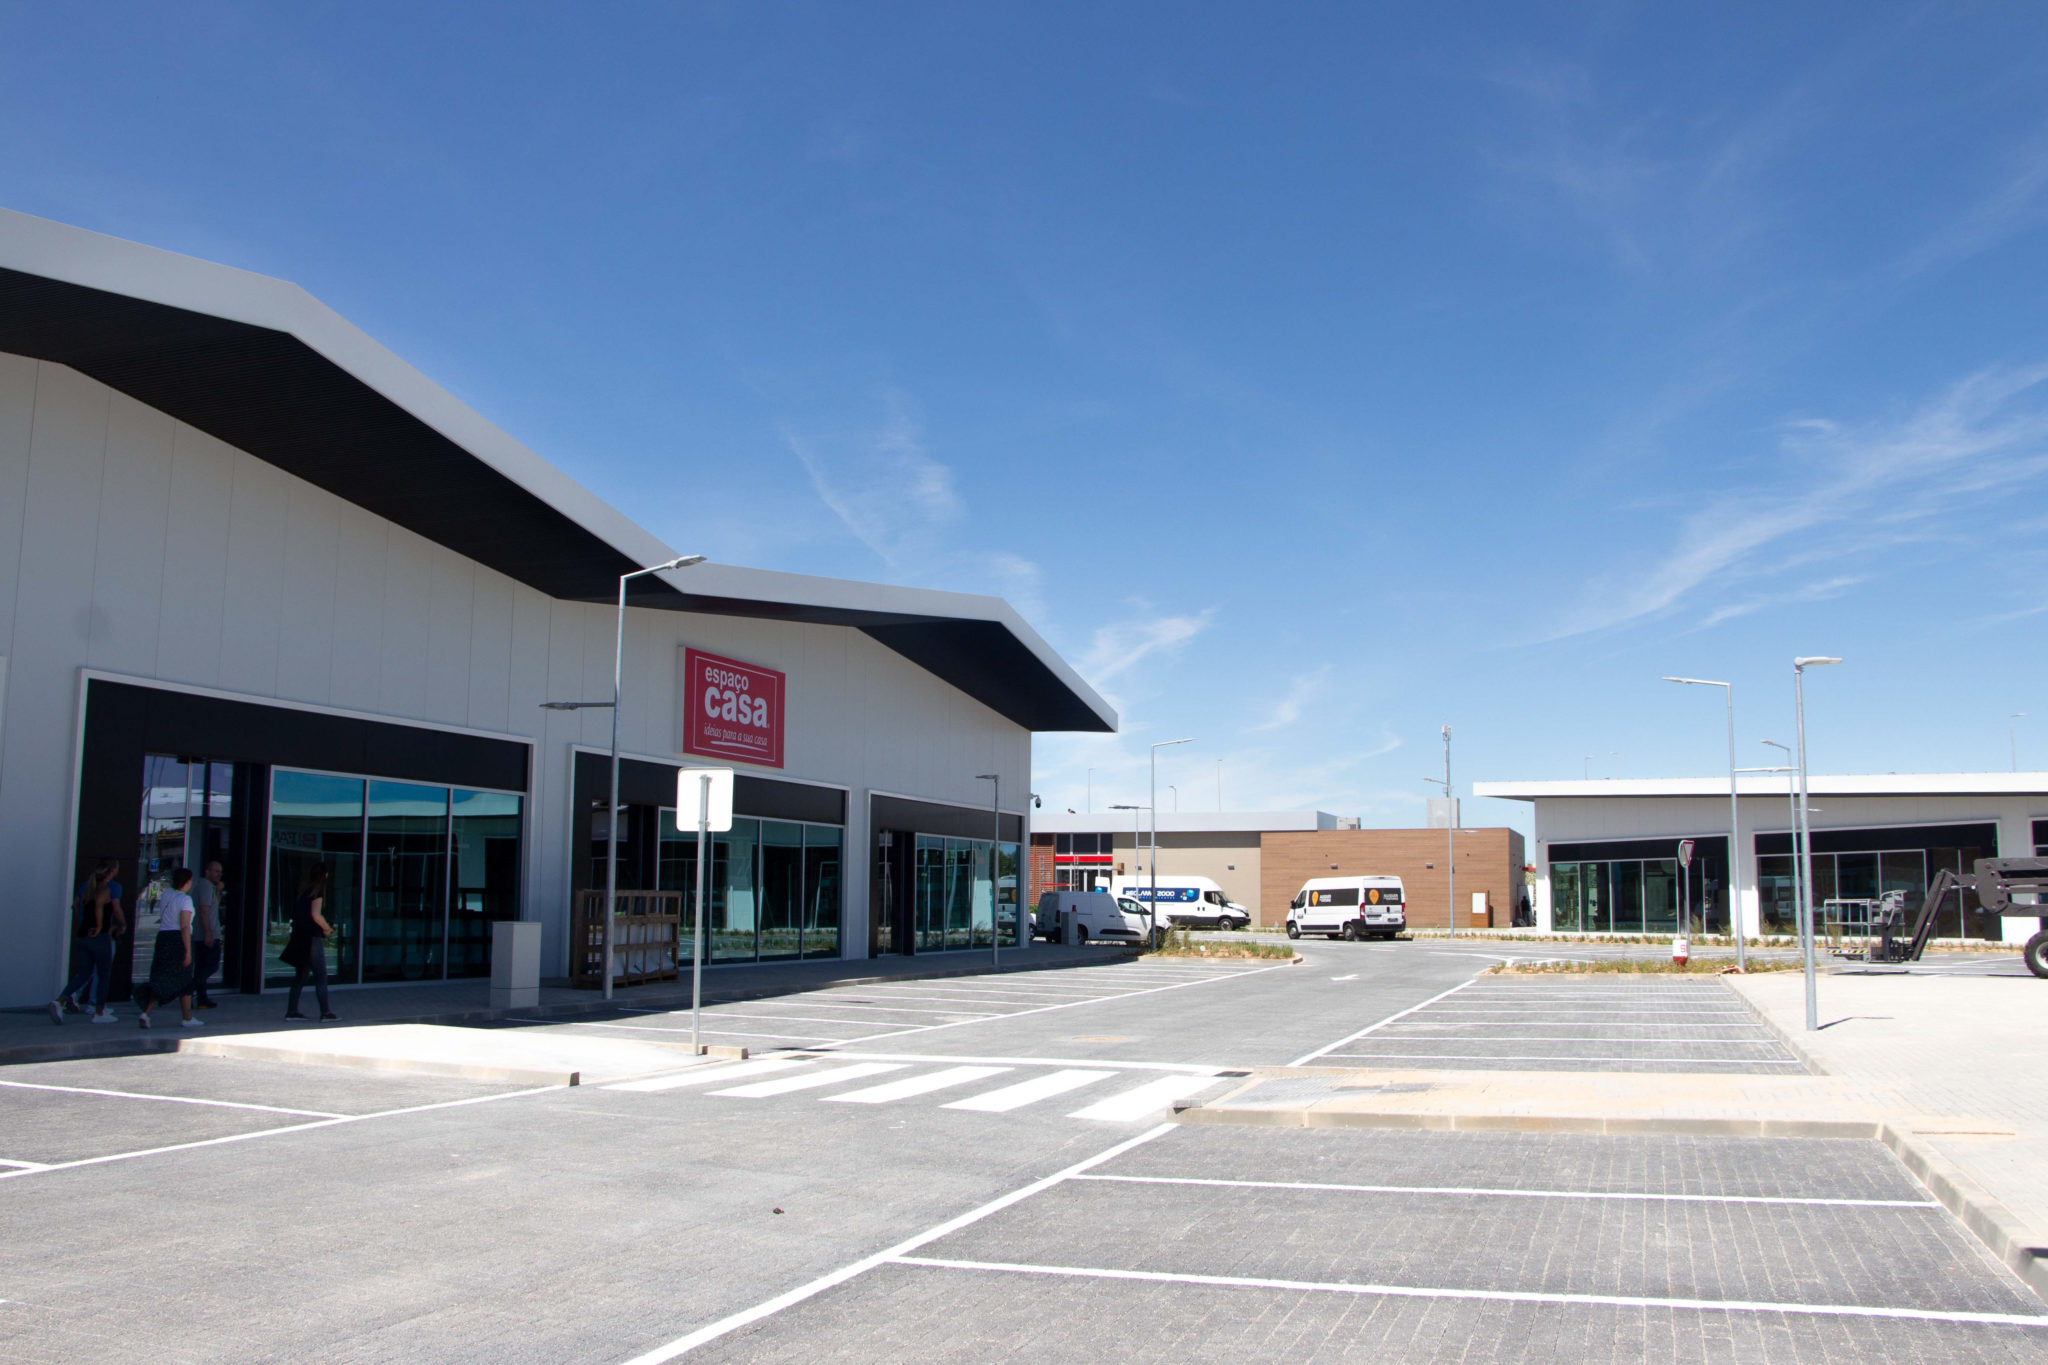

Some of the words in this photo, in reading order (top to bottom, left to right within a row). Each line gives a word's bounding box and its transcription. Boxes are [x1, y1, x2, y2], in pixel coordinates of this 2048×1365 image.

[705, 666, 749, 693] espaço
[704, 686, 768, 728] casa
[704, 721, 721, 737] ideias
[722, 727, 737, 741] para
[743, 733, 754, 744] sua
[754, 735, 768, 746] casa
